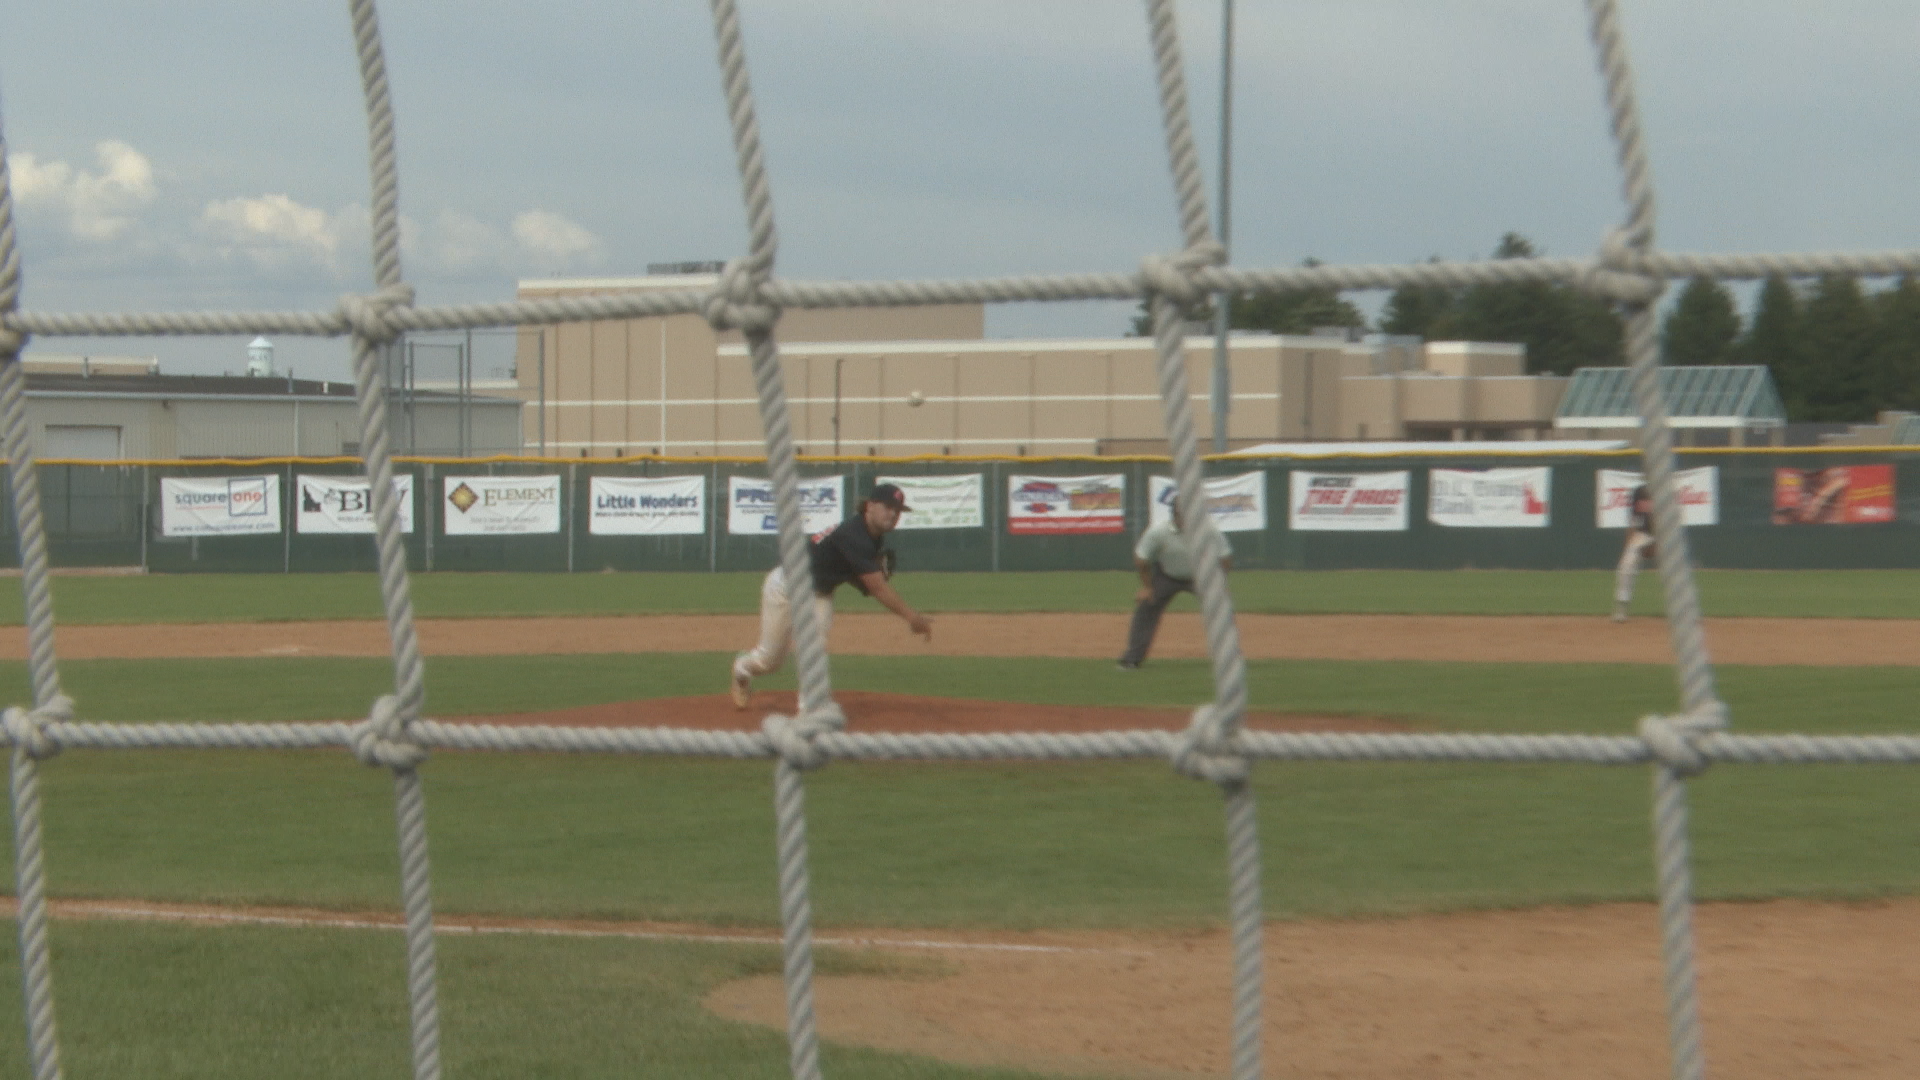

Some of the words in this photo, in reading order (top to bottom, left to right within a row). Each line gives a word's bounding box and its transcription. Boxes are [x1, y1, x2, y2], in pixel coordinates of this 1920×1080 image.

[175, 492, 227, 505] square
[232, 491, 262, 503] one
[483, 487, 557, 507] ELEMENT
[597, 495, 636, 509] Little
[640, 493, 698, 509] Wonders
